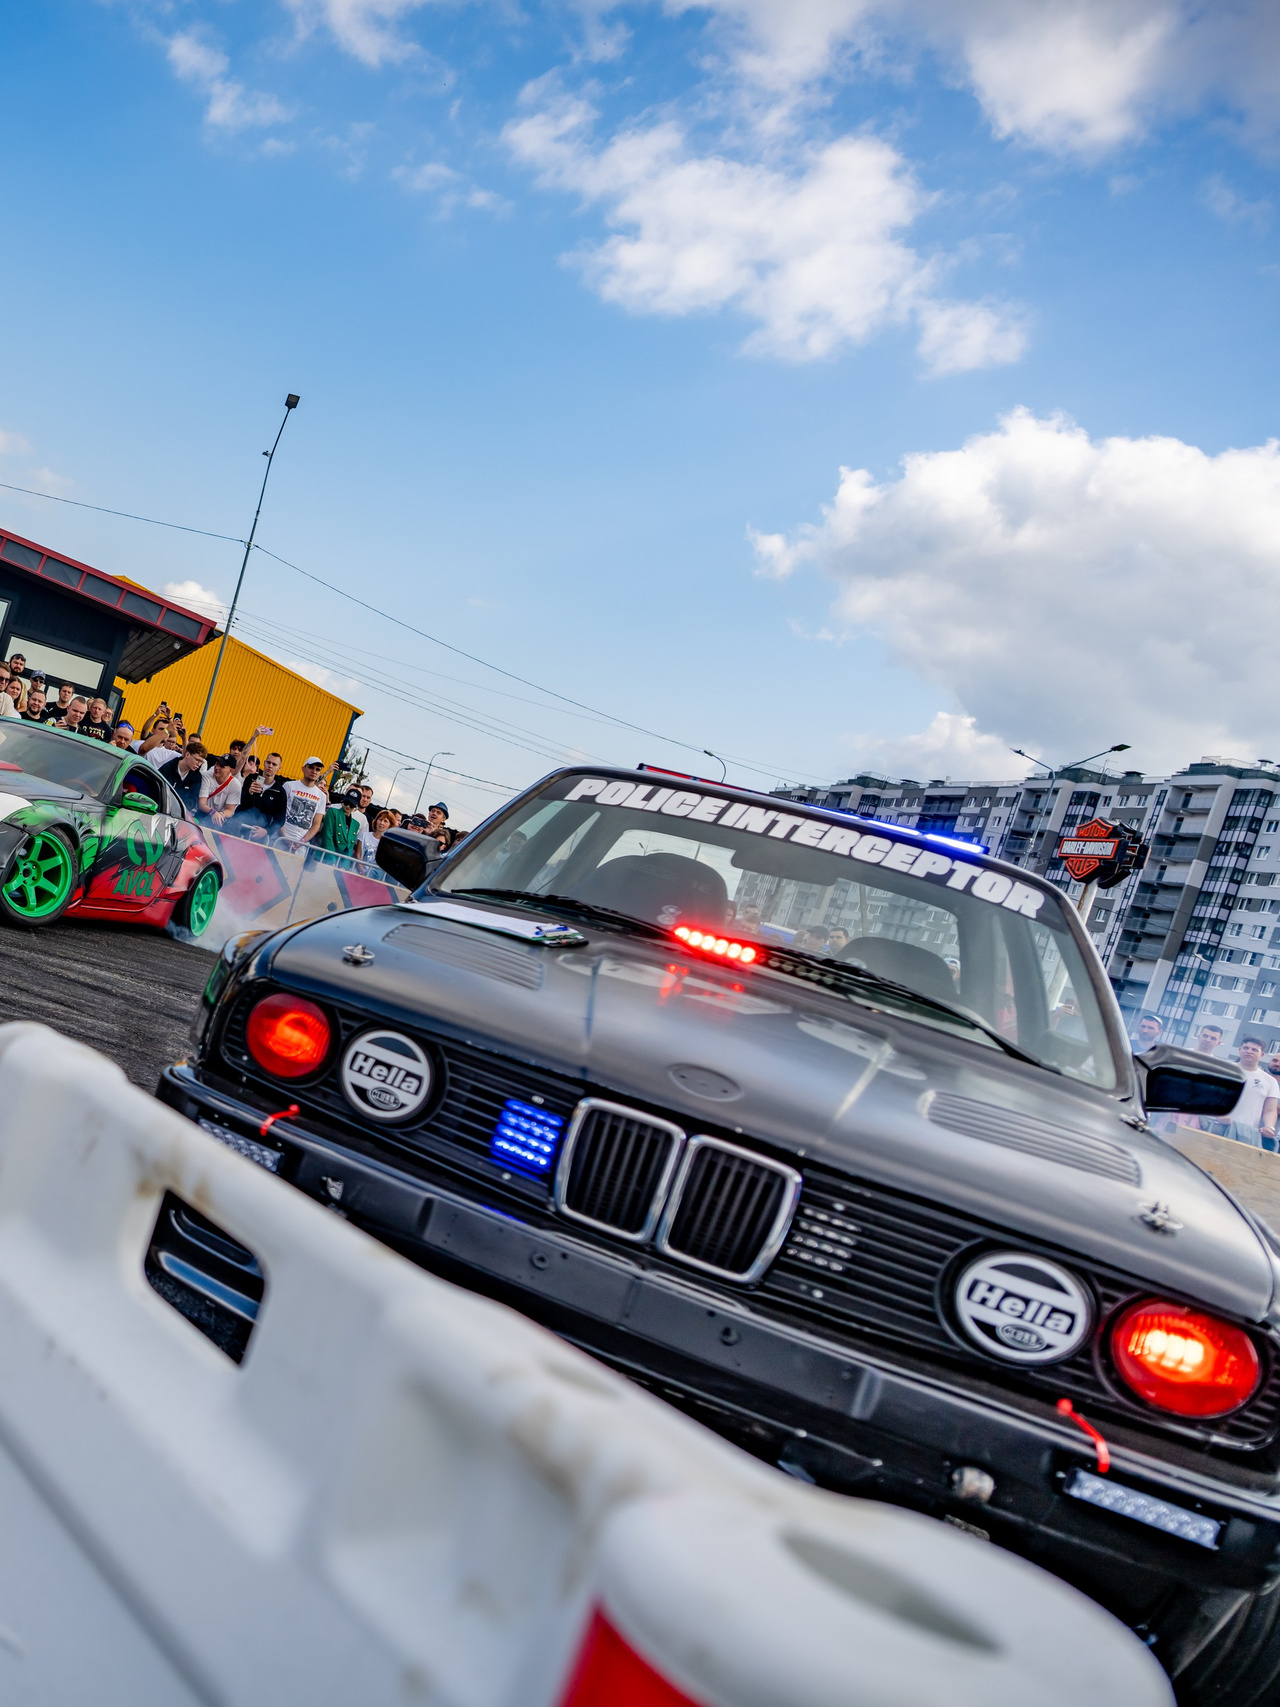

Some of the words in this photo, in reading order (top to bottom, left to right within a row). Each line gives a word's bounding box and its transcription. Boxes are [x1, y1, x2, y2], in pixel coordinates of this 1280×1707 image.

[1079, 822, 1108, 838] MOTOR
[563, 778, 731, 823] POLICE
[717, 803, 1045, 919] INTERCEPTOR
[1060, 840, 1116, 857] HARLEY-DAVIDSON
[111, 869, 156, 897] AVOL
[350, 1053, 421, 1095] Hella
[968, 1280, 1074, 1335] Hella
